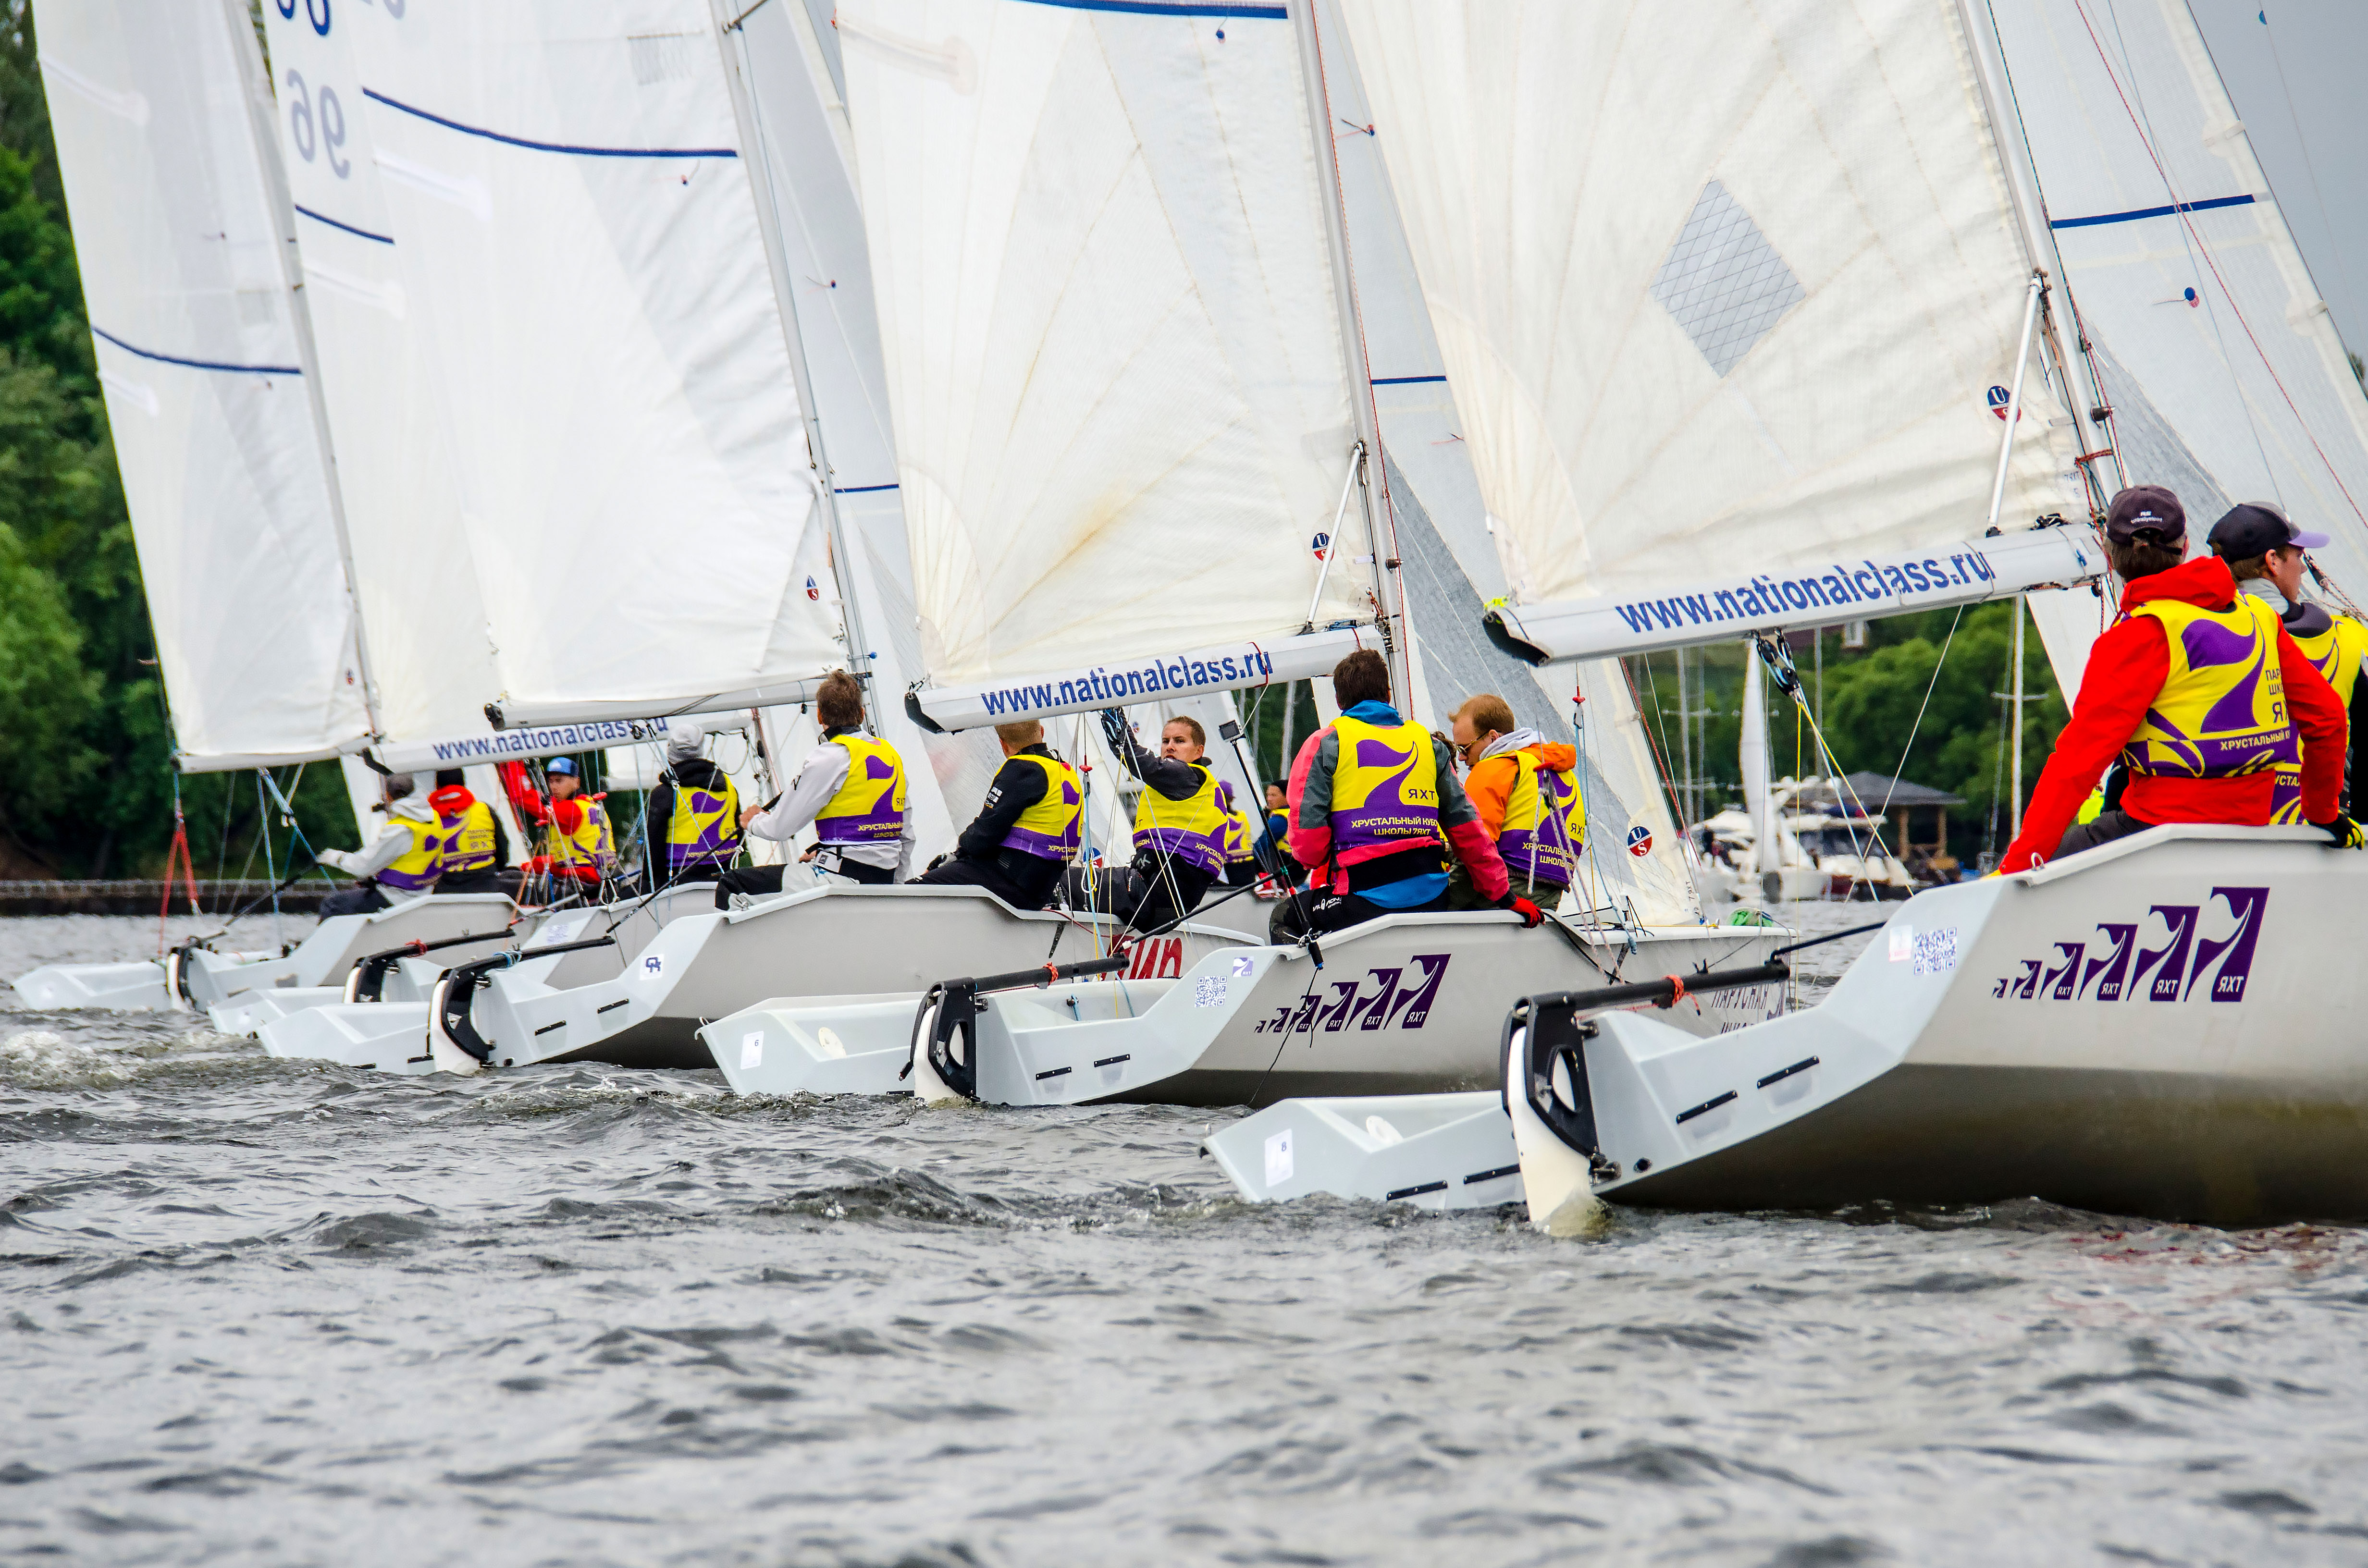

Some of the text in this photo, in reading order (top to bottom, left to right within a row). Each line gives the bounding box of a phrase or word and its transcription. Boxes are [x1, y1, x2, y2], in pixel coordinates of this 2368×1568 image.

[1615, 551, 1996, 633] www.nationalclass.ru
[981, 651, 1274, 716] www.nationalclass.ru
[2220, 730, 2284, 750] ХРУСТАЛЬНЫЙ
[1408, 788, 1435, 800] ЯХТ
[1351, 816, 1421, 829] ХРУСТАЛЬНЫЙ
[1374, 827, 1412, 835] ШКОЛЫ
[2101, 983, 2120, 995] ЯХТ
[2155, 980, 2178, 994] ЯХТ
[2217, 976, 2244, 992] ЯХТ
[2057, 986, 2072, 995] ЯХТ
[1365, 1016, 1381, 1026] ЯХТ
[1407, 1011, 1426, 1023] ЯХТ
[1281, 1141, 1287, 1152] 8
